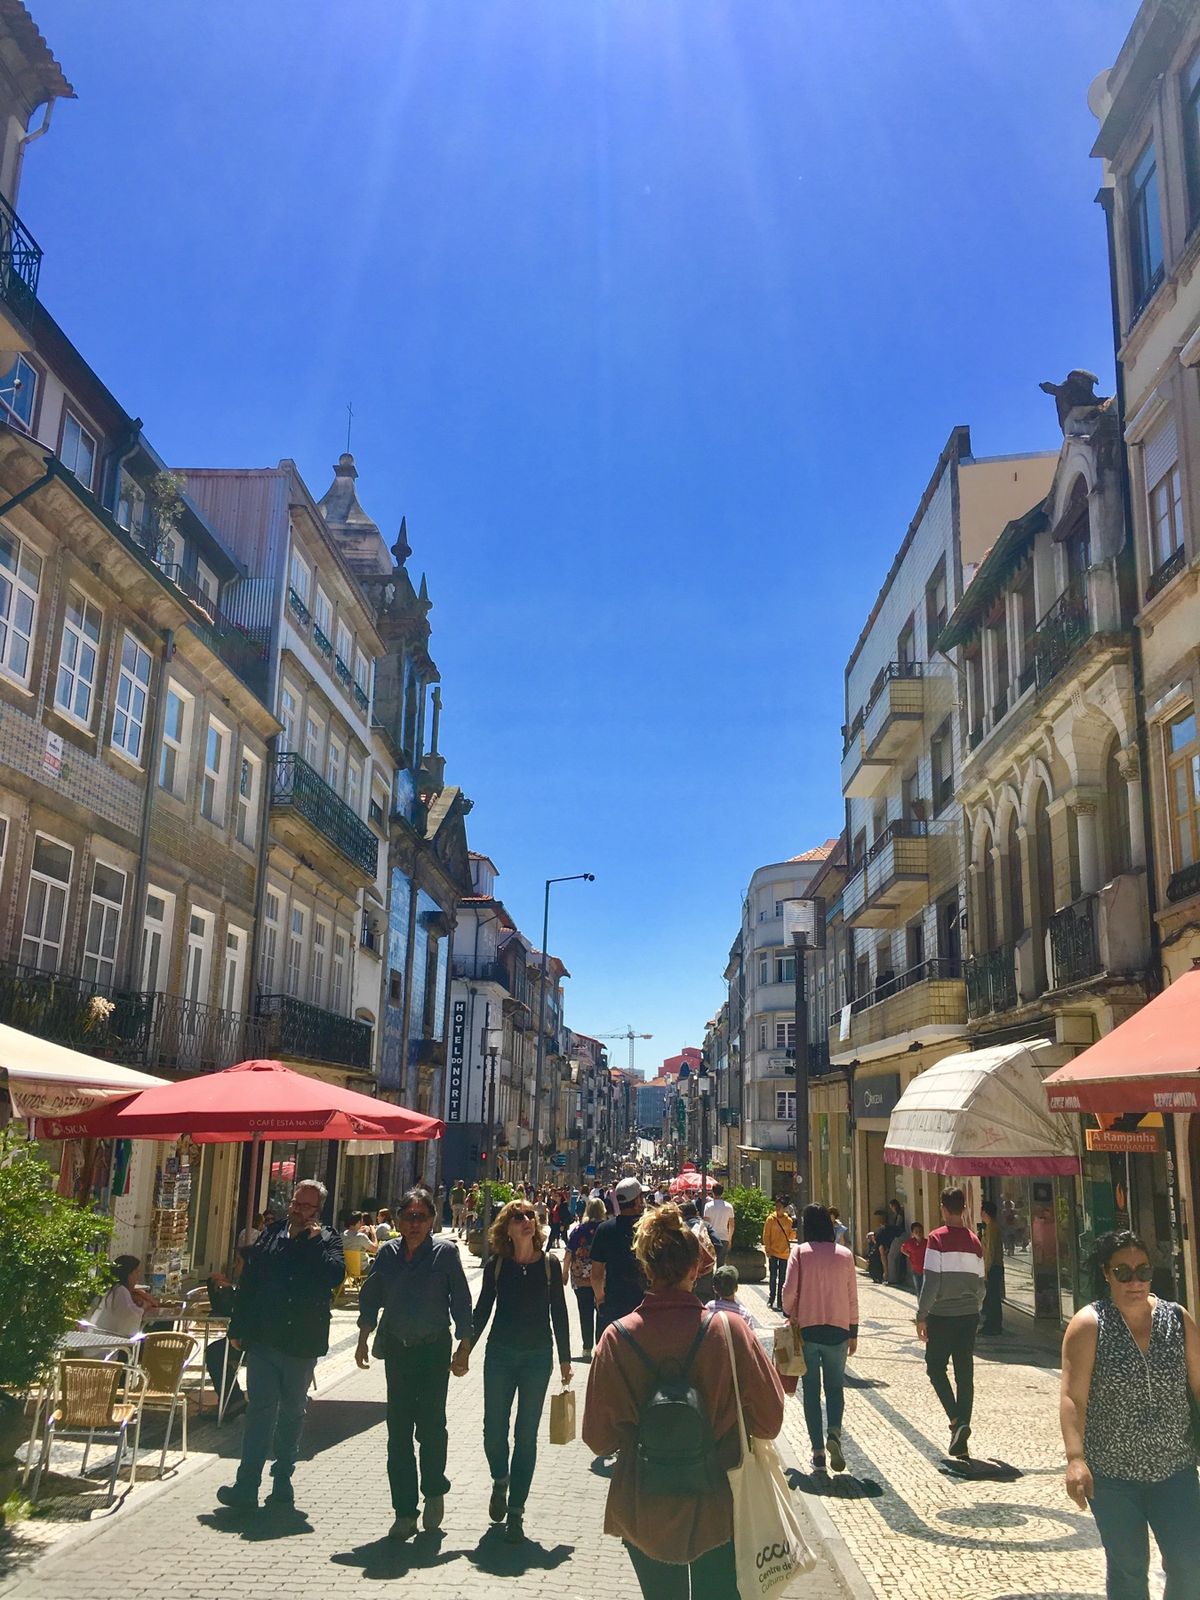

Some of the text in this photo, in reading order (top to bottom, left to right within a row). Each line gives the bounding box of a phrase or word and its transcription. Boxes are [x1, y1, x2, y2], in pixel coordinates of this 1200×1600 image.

[454, 1003, 464, 1055] HOTEL
[451, 1067, 461, 1119] NORTE
[64, 1125, 88, 1134] SICAL
[1093, 1131, 1156, 1143] A Rampinha
[1091, 1142, 1156, 1152] RESTAURANTE
[759, 1565, 781, 1583] Centre
[782, 1561, 792, 1571] de
